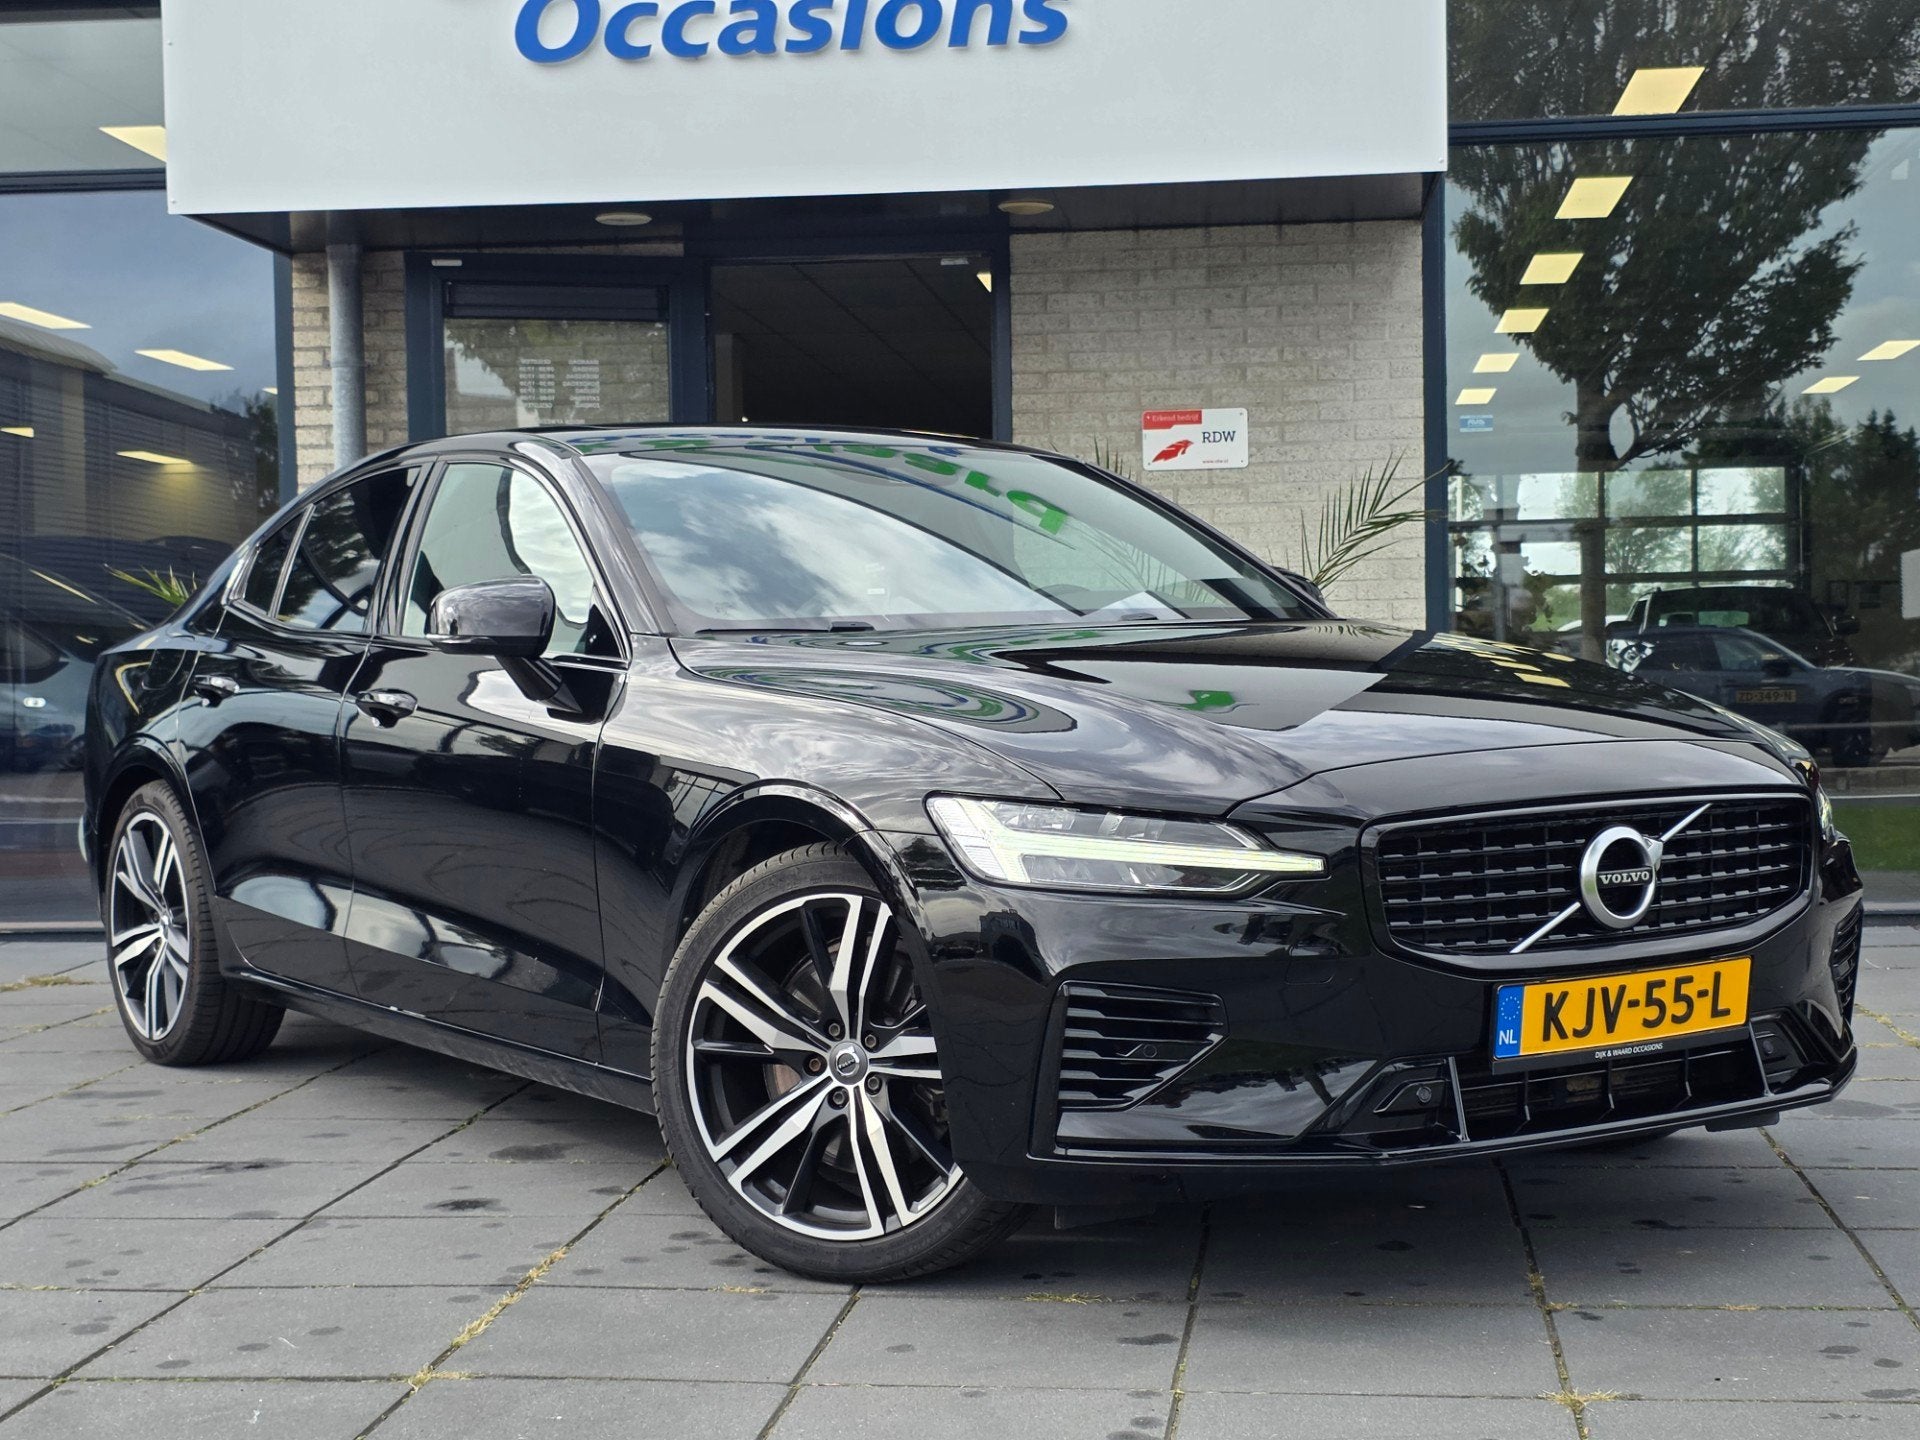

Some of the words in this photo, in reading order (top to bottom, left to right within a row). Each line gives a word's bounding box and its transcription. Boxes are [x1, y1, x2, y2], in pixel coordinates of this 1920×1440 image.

[514, 0, 1068, 64] Occasions
[1202, 430, 1236, 443] RDW
[1599, 871, 1650, 885] VOLVO
[1542, 971, 1731, 1042] KJV-55-L
[1498, 1030, 1517, 1046] NL
[1633, 1042, 1664, 1053] OCCASIONS
